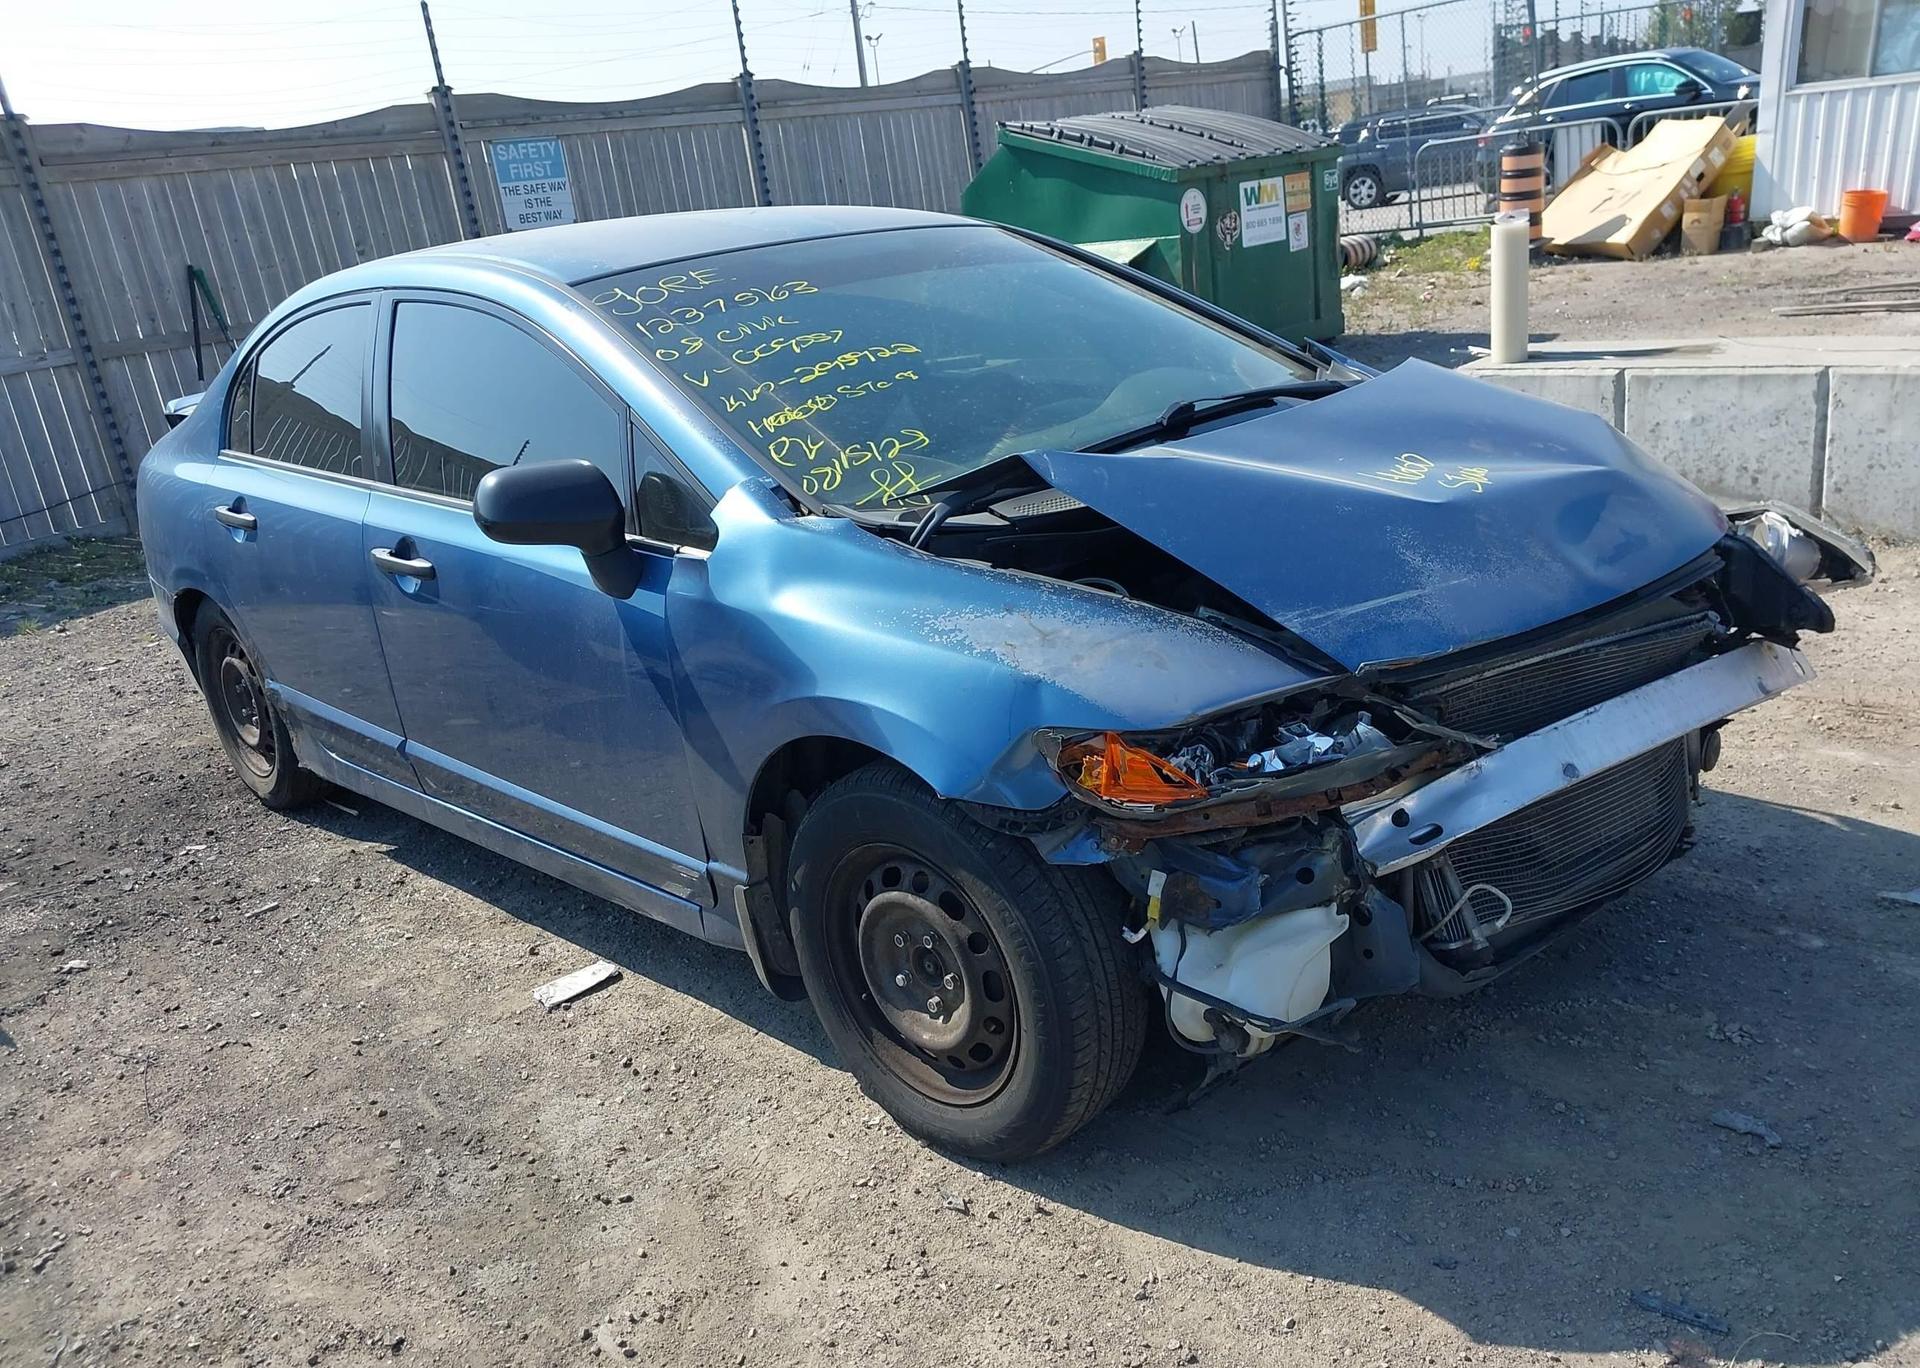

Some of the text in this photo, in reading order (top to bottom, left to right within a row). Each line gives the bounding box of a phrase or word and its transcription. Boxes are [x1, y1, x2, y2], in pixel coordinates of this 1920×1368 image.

[497, 141, 556, 160] SAFETY
[509, 161, 552, 179] FIRST
[502, 181, 567, 197] THE SAFE WAY
[1243, 181, 1279, 206] WM
[525, 197, 552, 209] IS THE
[519, 210, 562, 224] BEST WAY
